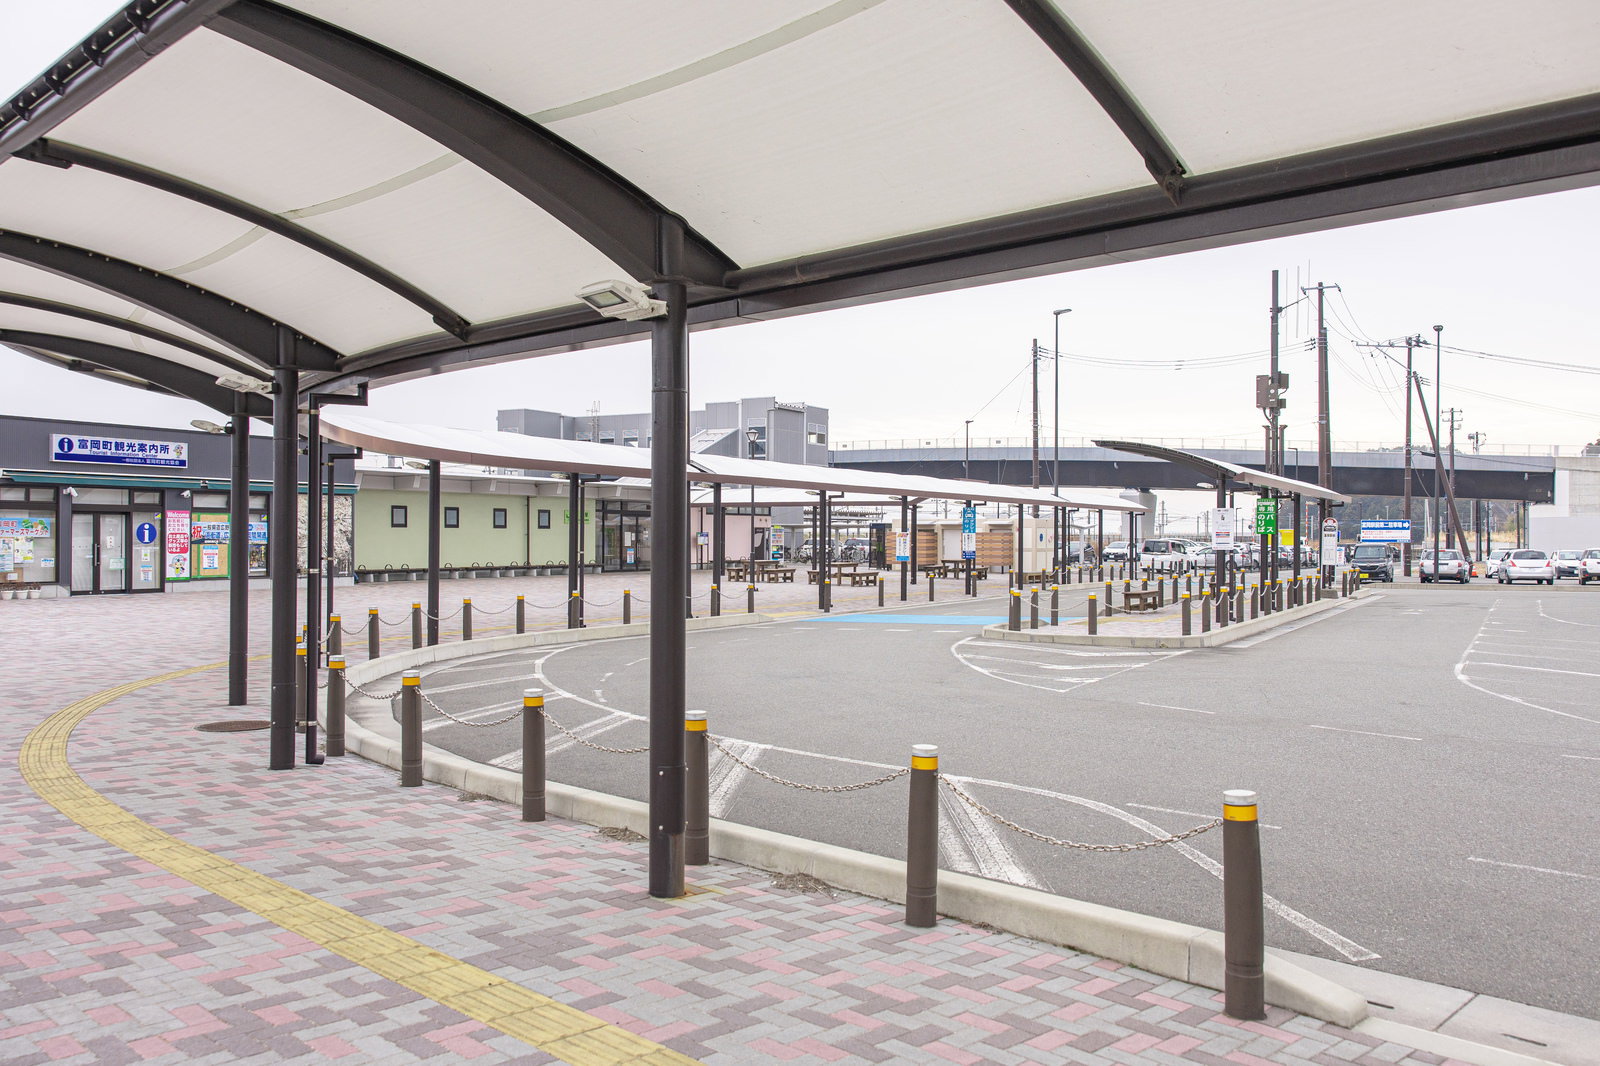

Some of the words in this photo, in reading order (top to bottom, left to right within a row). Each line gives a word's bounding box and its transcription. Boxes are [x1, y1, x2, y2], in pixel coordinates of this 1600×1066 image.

[78, 439, 170, 455] 富岡町観光案内所
[192, 525, 202, 539] 祝
